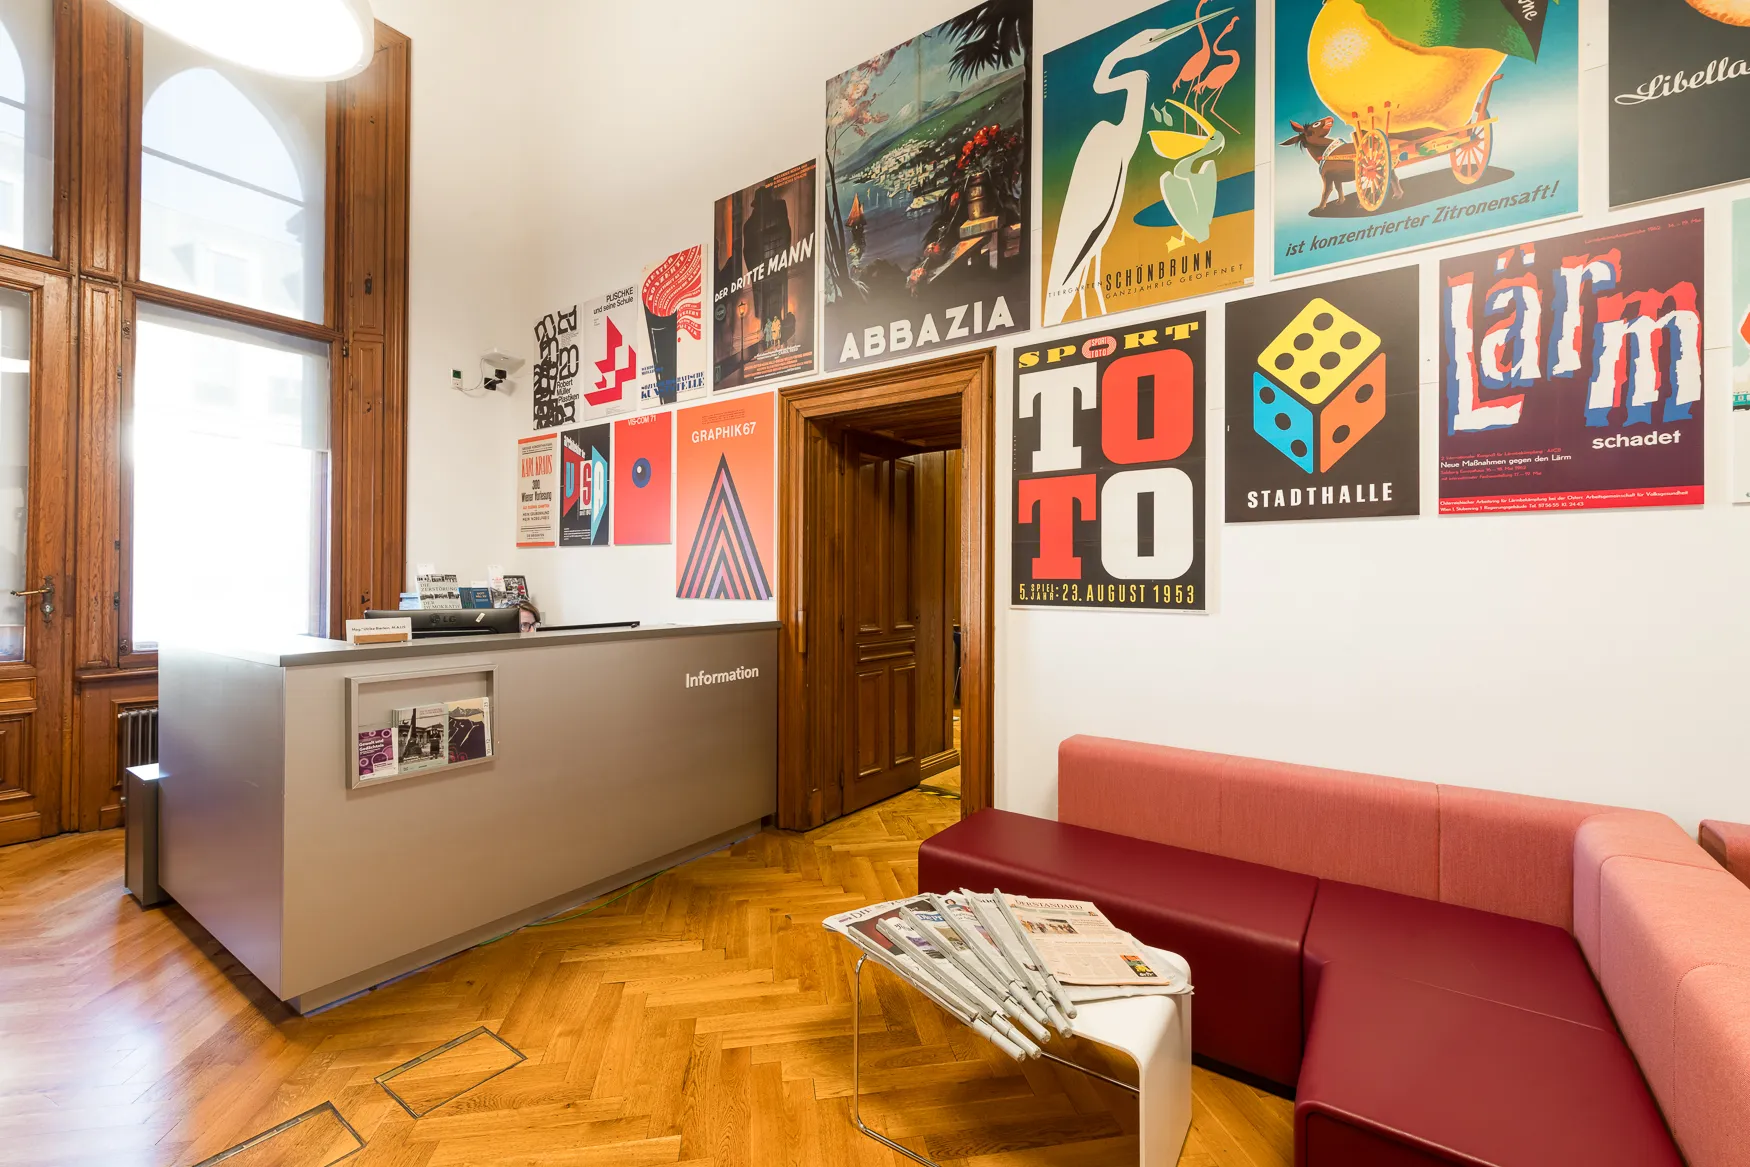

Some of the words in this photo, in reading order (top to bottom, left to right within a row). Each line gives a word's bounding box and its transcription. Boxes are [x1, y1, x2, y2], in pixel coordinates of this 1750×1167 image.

[1286, 240, 1305, 257] ist
[1309, 213, 1429, 252] konzentrierter
[1432, 180, 1560, 224] Zitronensaft!
[715, 287, 729, 303] DER
[731, 263, 765, 293] DRITTE
[767, 232, 815, 276] MANN
[1105, 250, 1213, 291] SCHÖNBRUNN
[1048, 281, 1102, 298] TIERGARTEN
[593, 306, 603, 315] und
[603, 302, 616, 311] seine
[617, 296, 634, 307] Schule
[839, 296, 1015, 363] ABBAZIA
[1444, 243, 1702, 436] Lärm
[1019, 321, 1199, 369] SPORT
[1091, 348, 1107, 358] TOTO
[557, 379, 573, 389] Robert
[627, 415, 650, 426] VIS-COM
[649, 414, 657, 423] 71
[691, 424, 742, 443] GRAPHIK
[743, 421, 757, 436] 67
[1592, 430, 1682, 449] schadet
[521, 457, 534, 478] KARL
[535, 455, 553, 475] KRAUS
[1462, 459, 1507, 467] Maßnahmen
[1509, 457, 1532, 465] gegen
[521, 492, 534, 502] Wiener
[534, 491, 552, 502] Vorlesung
[1247, 482, 1393, 508] STADTHALLE
[1020, 584, 1029, 600] 5.
[1062, 584, 1082, 602] 23.
[1086, 585, 1146, 603] AUGUST
[1153, 585, 1195, 604] 1953
[443, 615, 457, 623] LG
[685, 665, 759, 688] Information
